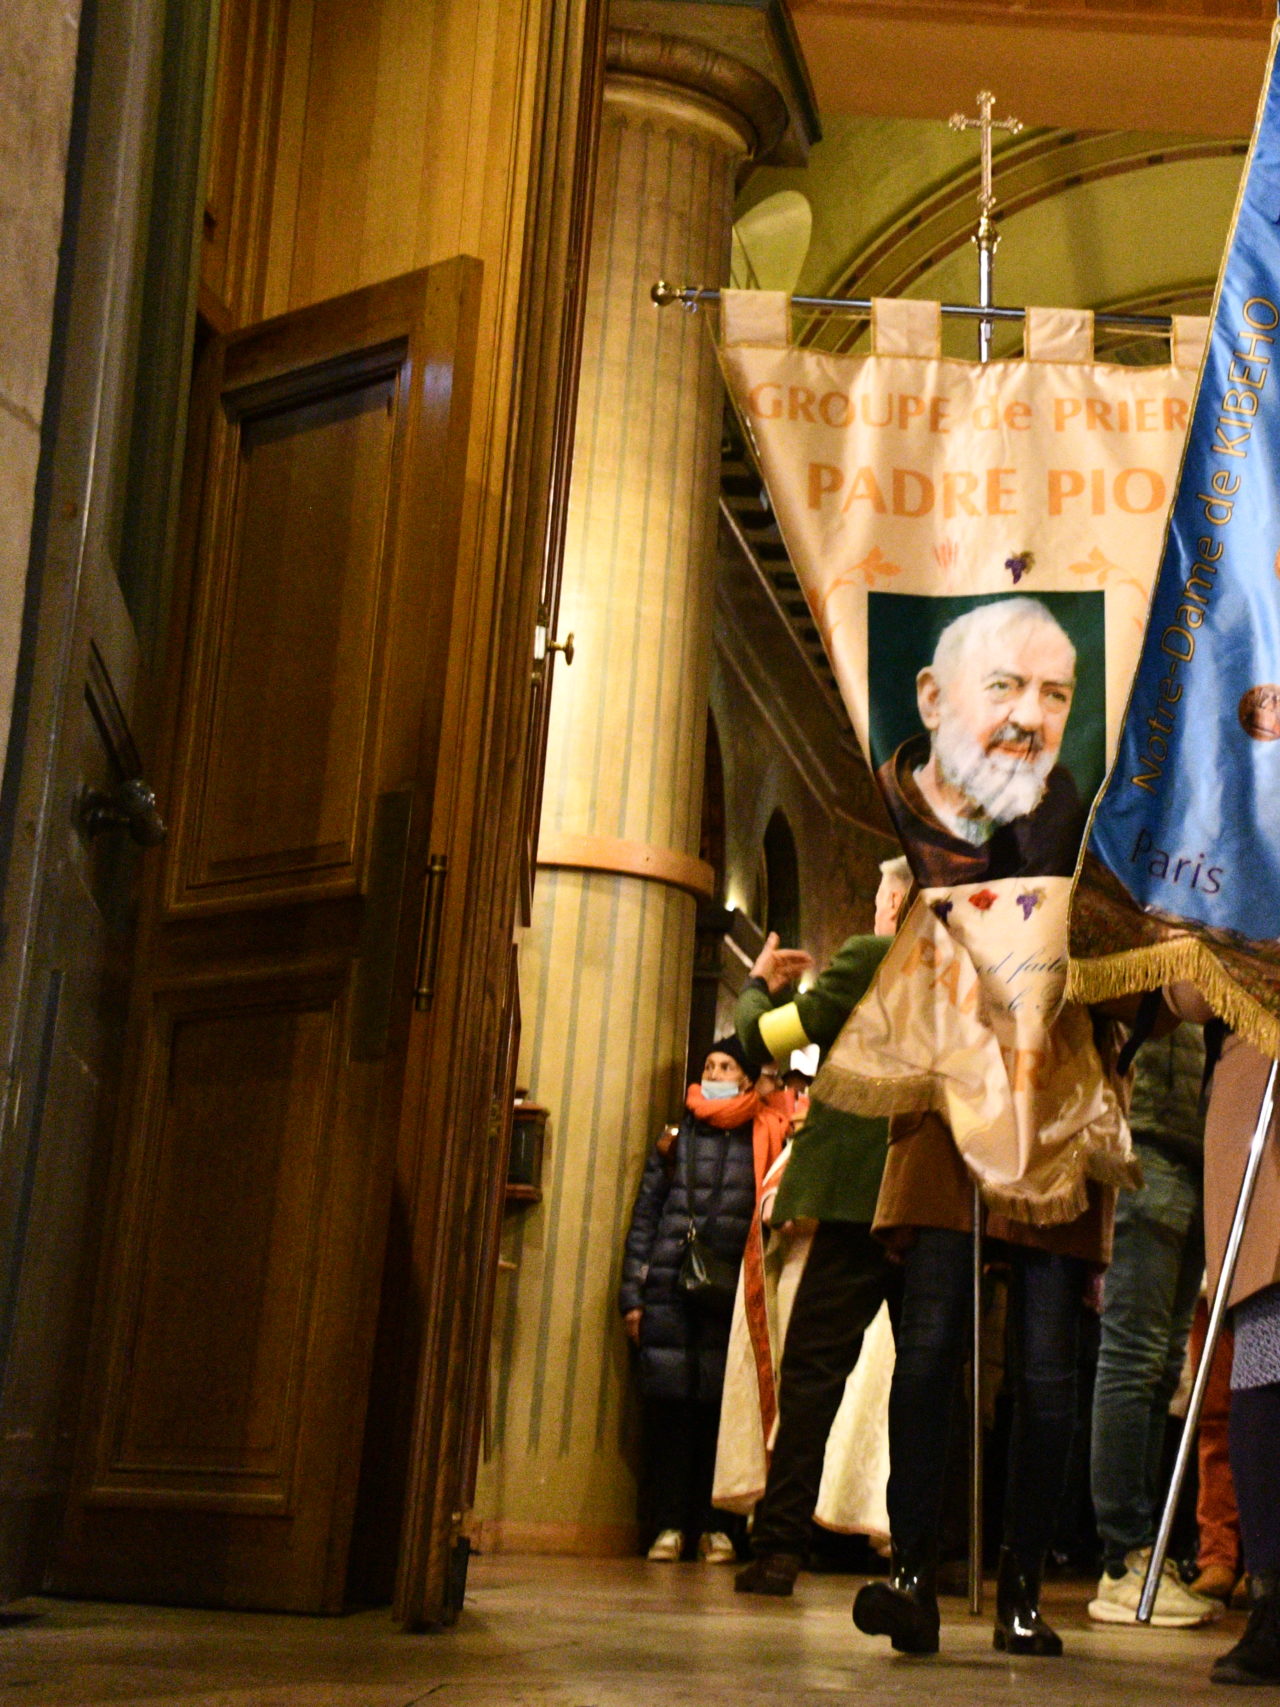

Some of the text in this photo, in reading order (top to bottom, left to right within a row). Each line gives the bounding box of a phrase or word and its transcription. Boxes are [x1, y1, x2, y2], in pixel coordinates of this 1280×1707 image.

[749, 382, 1189, 433] GROUPE de PRIER
[807, 463, 1167, 519] PADRE PIO
[1131, 296, 1280, 794] Notre-Dame de KIBEHO
[1130, 827, 1224, 896] Paris
